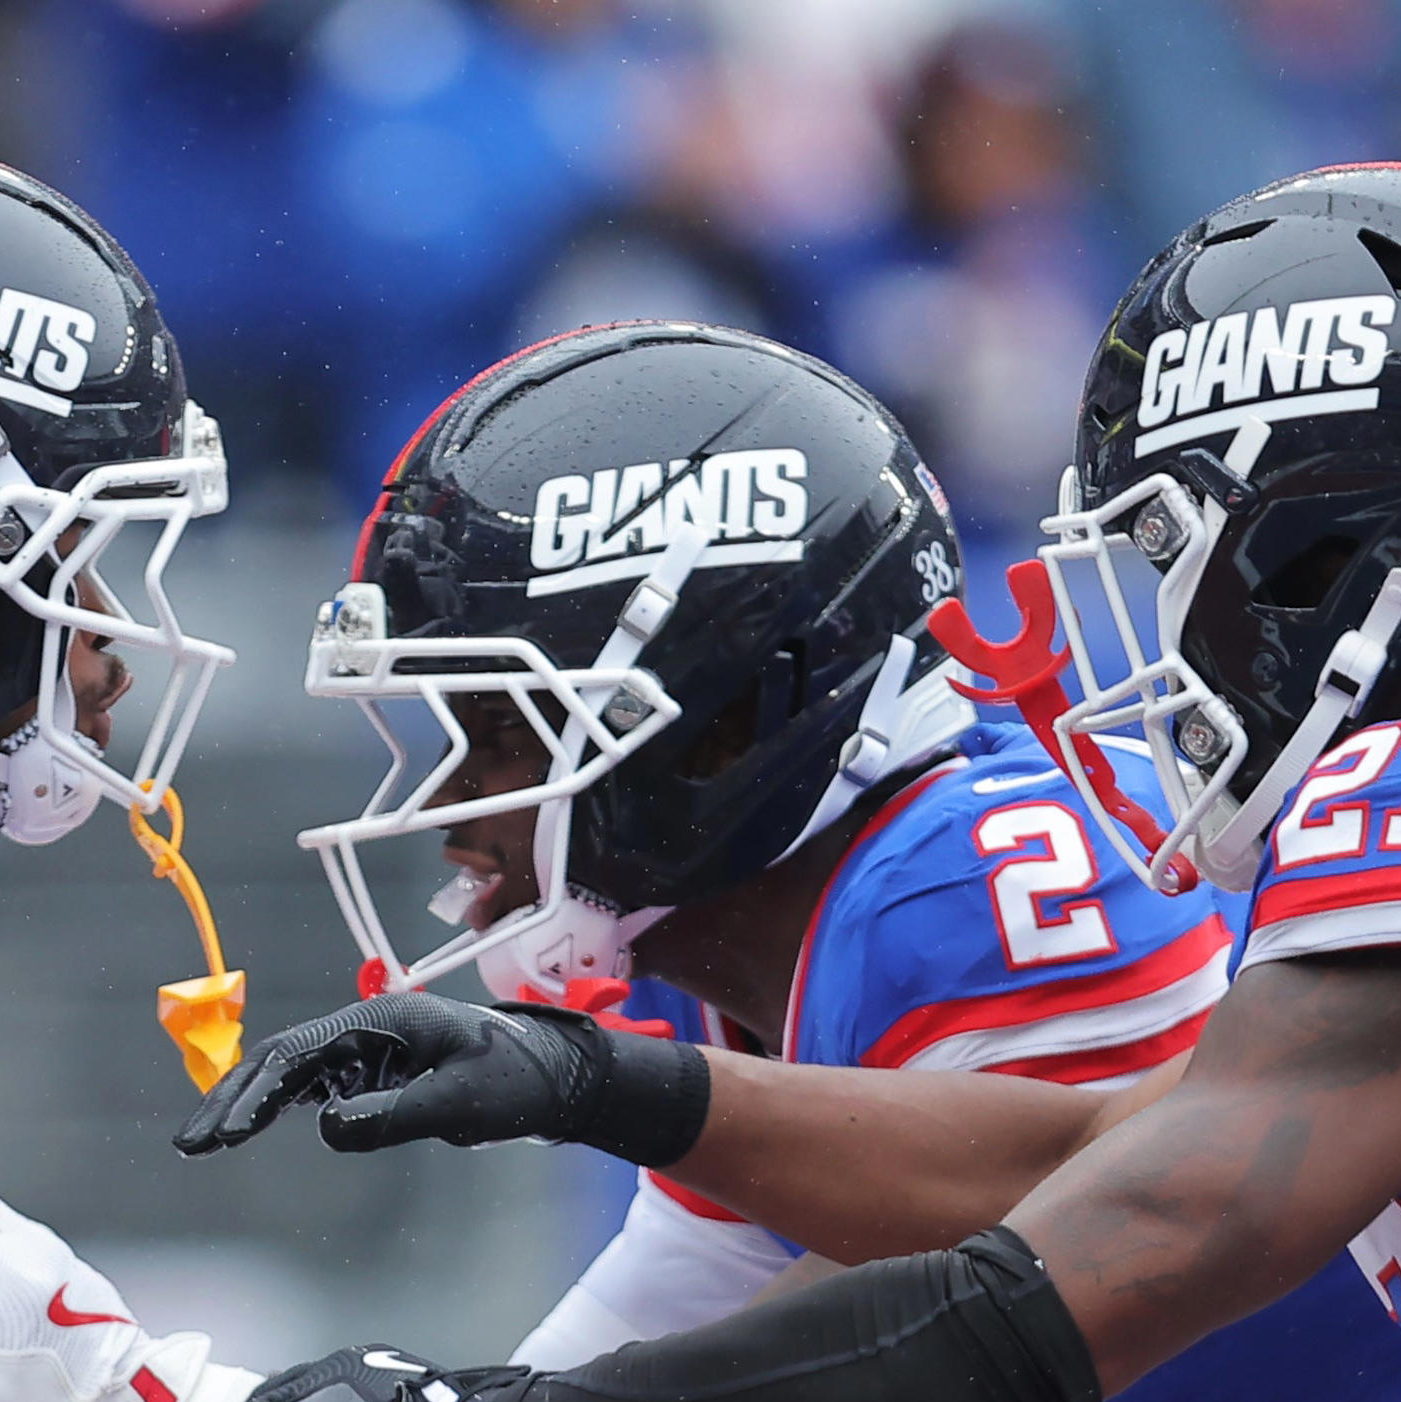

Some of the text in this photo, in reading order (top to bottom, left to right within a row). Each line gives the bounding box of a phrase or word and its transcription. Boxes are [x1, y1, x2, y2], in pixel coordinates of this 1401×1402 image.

[1137, 295, 1396, 428] GIANTS
[529, 448, 808, 571] GIANTS
[915, 540, 955, 603] 38
[971, 799, 1117, 971] 2
